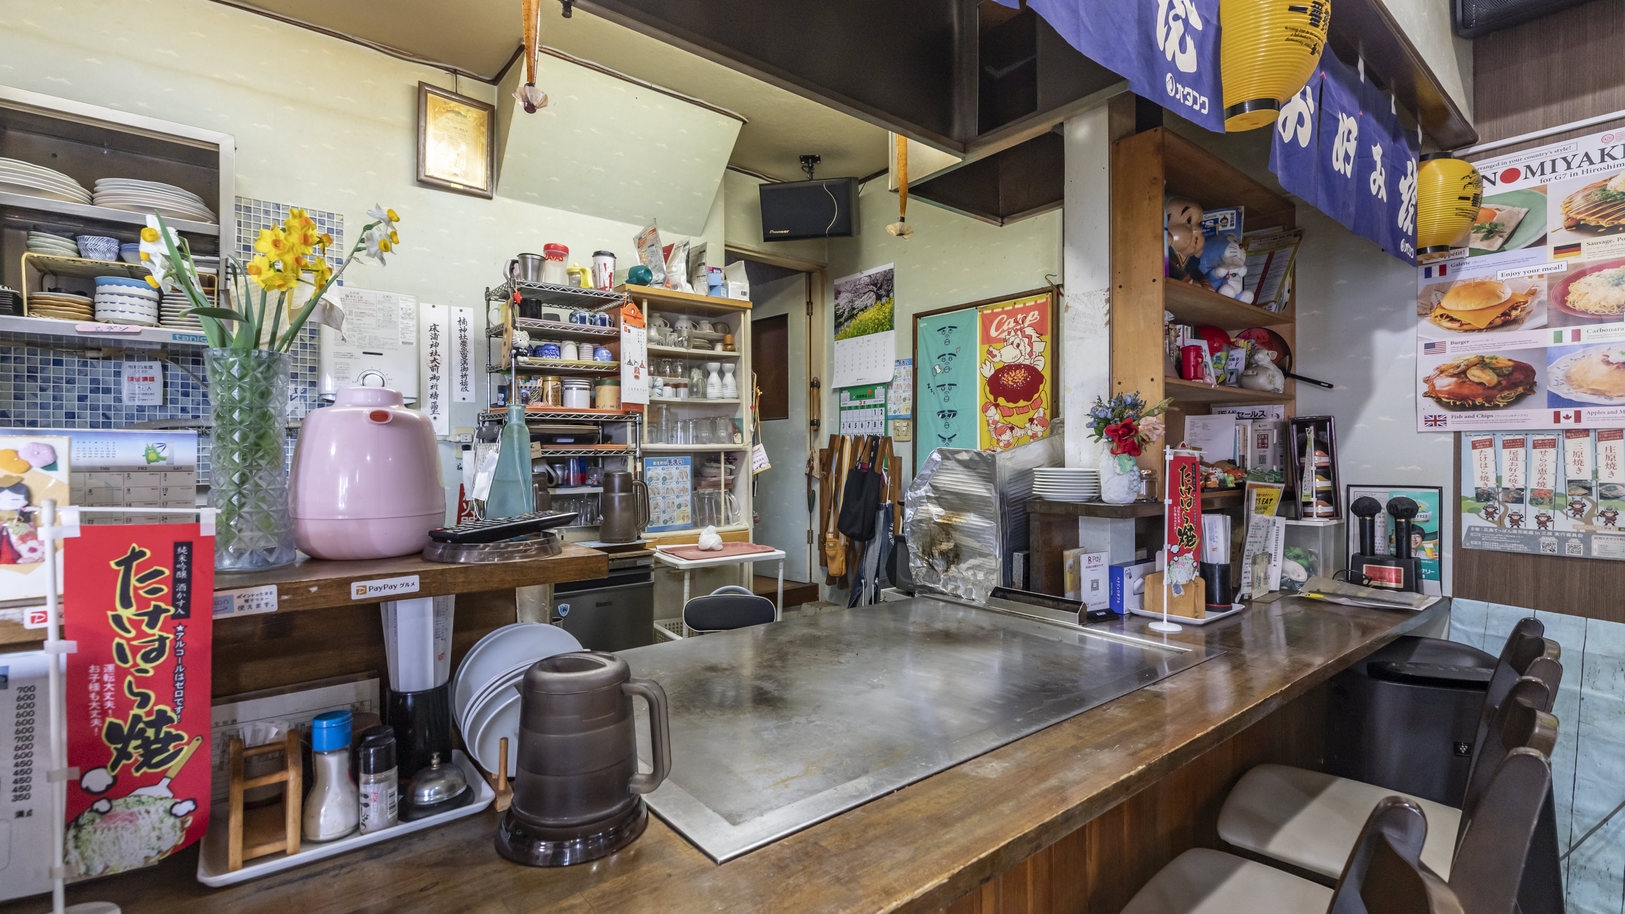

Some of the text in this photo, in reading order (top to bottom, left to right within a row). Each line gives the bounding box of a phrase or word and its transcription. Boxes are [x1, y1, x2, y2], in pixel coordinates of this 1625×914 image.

[1477, 162, 1500, 171] ranged
[1554, 173, 1567, 181] G7
[1581, 163, 1625, 176] Hiroshim
[1501, 270, 1522, 279] Enjoy
[1523, 268, 1540, 276] your
[1542, 264, 1563, 272] meal!
[990, 310, 1040, 338] Carp
[174, 334, 208, 342] tanic
[1178, 463, 1198, 550] たけはら焼
[368, 584, 398, 592] PayPay
[175, 583, 187, 614] 酒かす入
[238, 602, 274, 611] 使えます。
[103, 544, 187, 775] たけはら焼
[103, 664, 116, 717] 運転大丈夫！
[16, 694, 36, 702] 600
[88, 665, 102, 736] お子様も大丈夫！
[16, 702, 35, 710] 600
[16, 710, 35, 718] 600
[15, 718, 35, 727] 600
[15, 727, 34, 735] 600
[15, 735, 34, 743] 700
[14, 743, 34, 752] 600
[14, 751, 33, 760] 600
[14, 760, 33, 768] 450
[13, 768, 33, 776] 450
[13, 776, 32, 785] 450
[12, 784, 32, 793] 450
